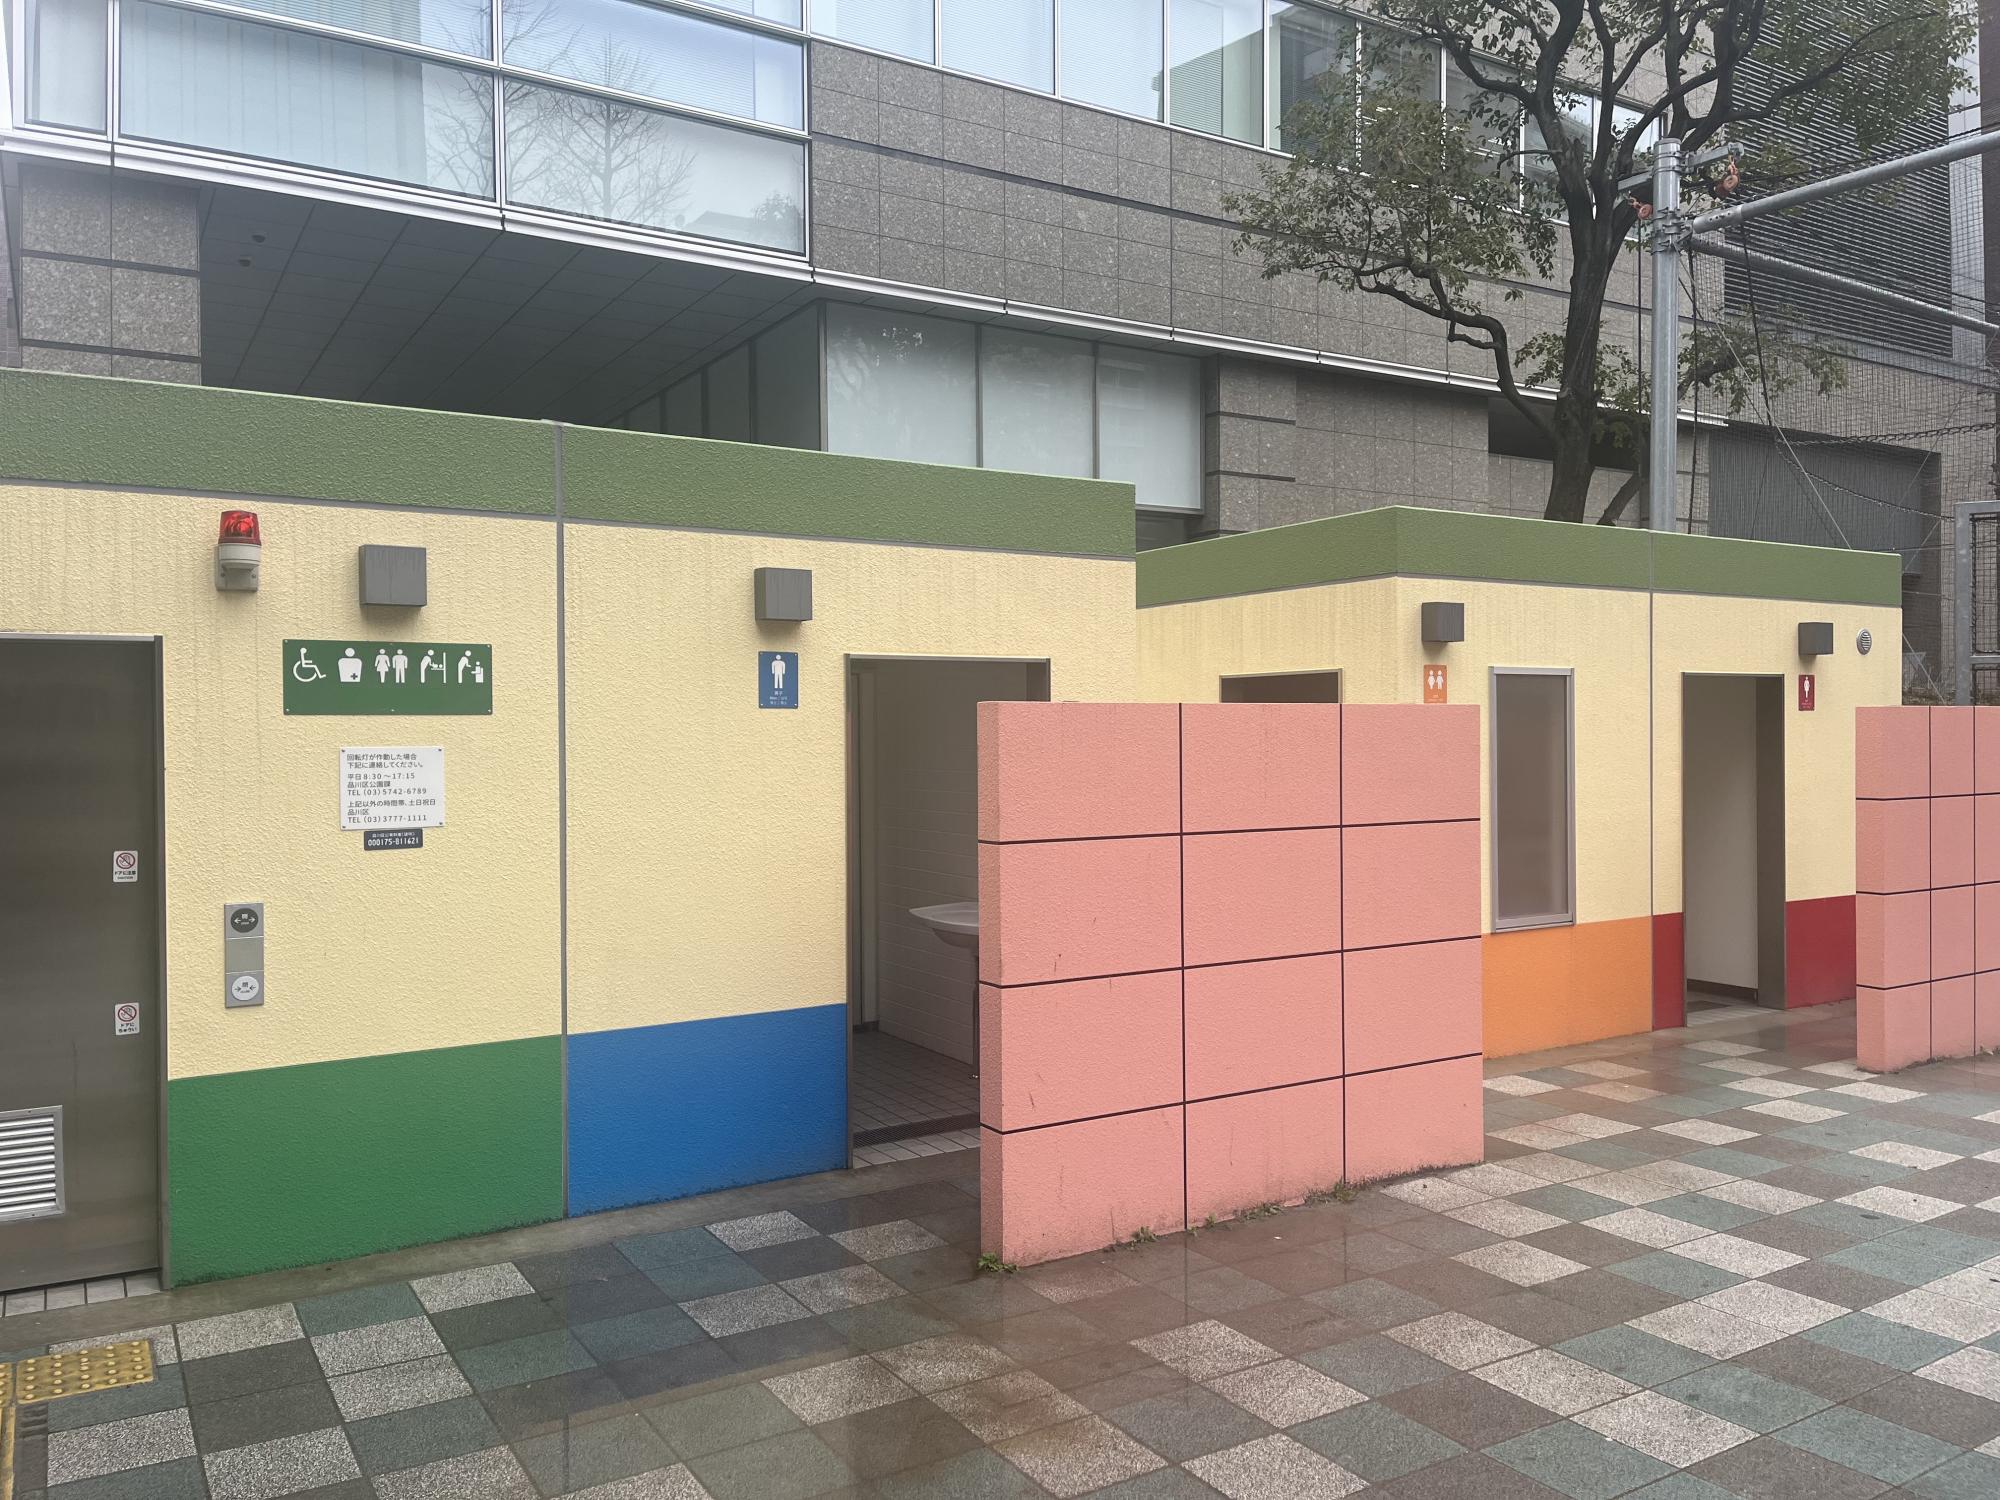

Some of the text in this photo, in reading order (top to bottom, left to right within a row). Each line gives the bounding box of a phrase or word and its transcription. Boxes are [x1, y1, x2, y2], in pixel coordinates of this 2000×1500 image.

[347, 761, 424, 769] 下記に連絡してください。
[347, 799, 436, 808] 上記以外の時間帯、土日祝日
